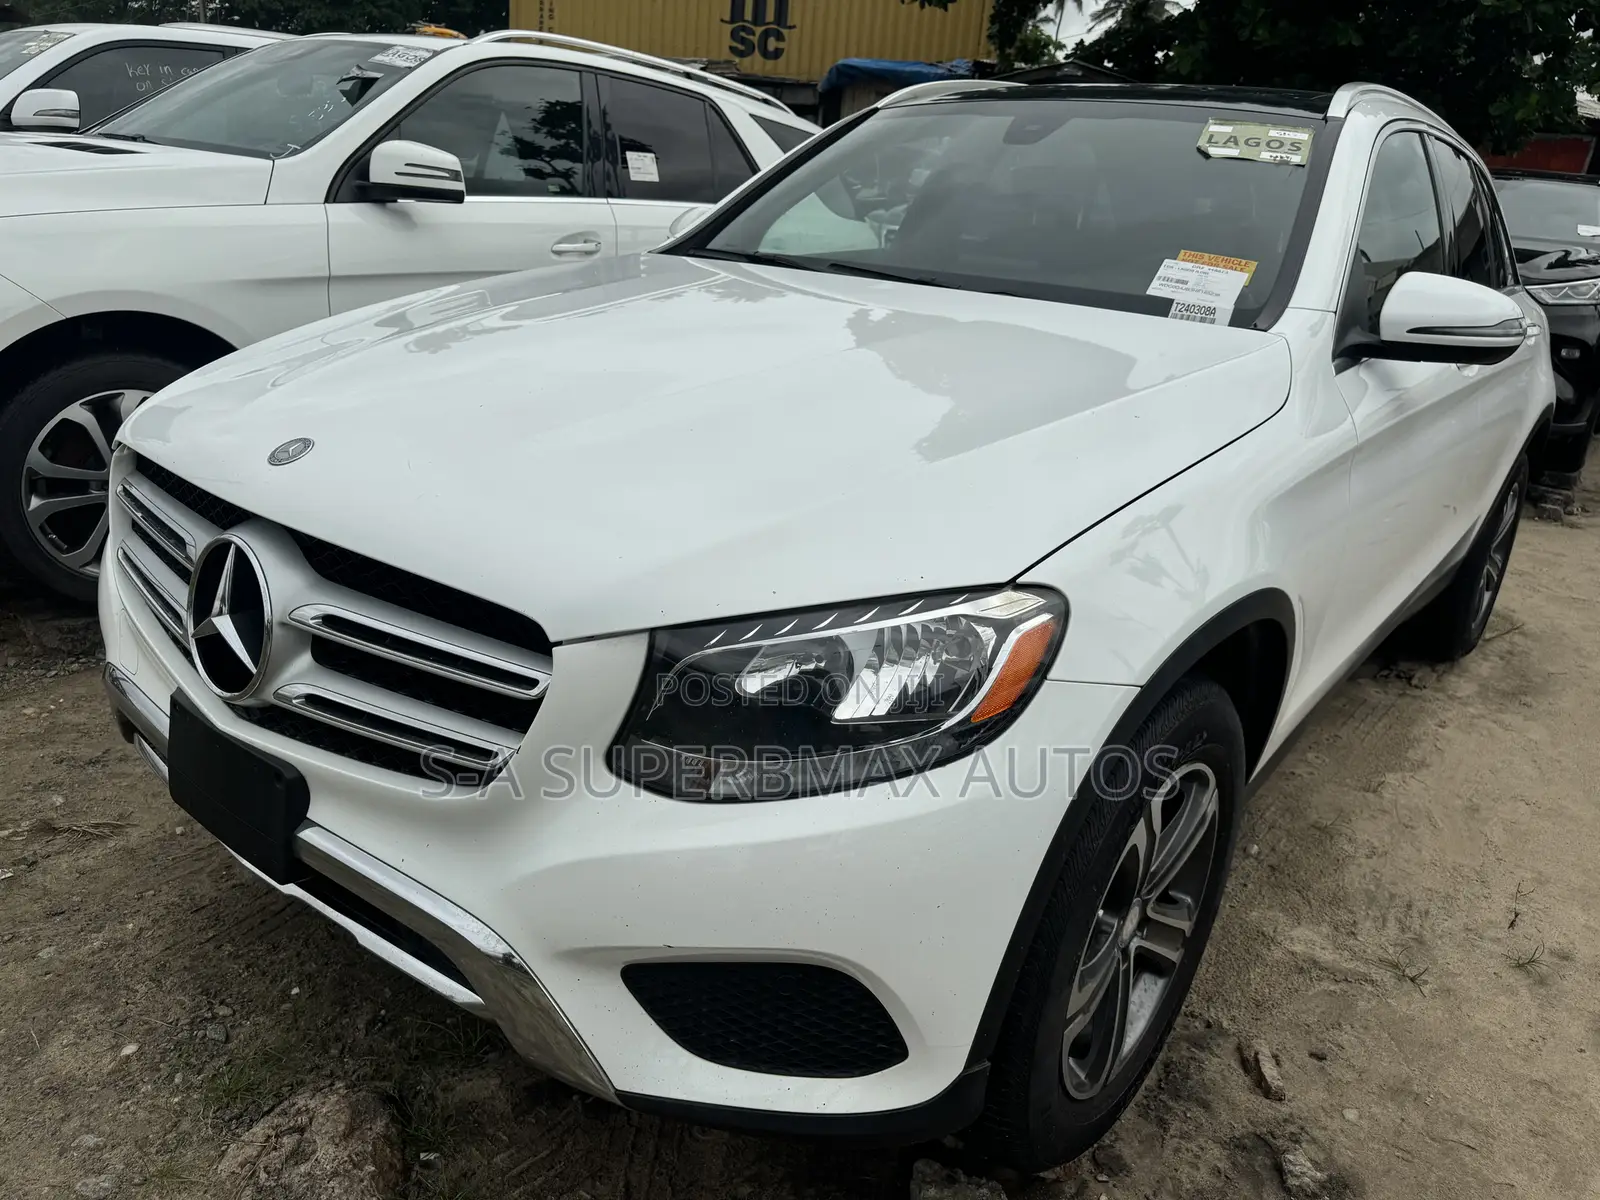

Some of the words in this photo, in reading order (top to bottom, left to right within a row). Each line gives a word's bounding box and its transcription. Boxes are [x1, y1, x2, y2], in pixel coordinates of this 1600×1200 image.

[1206, 133, 1303, 152] LAGOS
[1182, 251, 1206, 260] THIS
[1208, 254, 1250, 268] VEHICLE
[1221, 262, 1246, 273] SALE
[1174, 302, 1217, 318] T240308A
